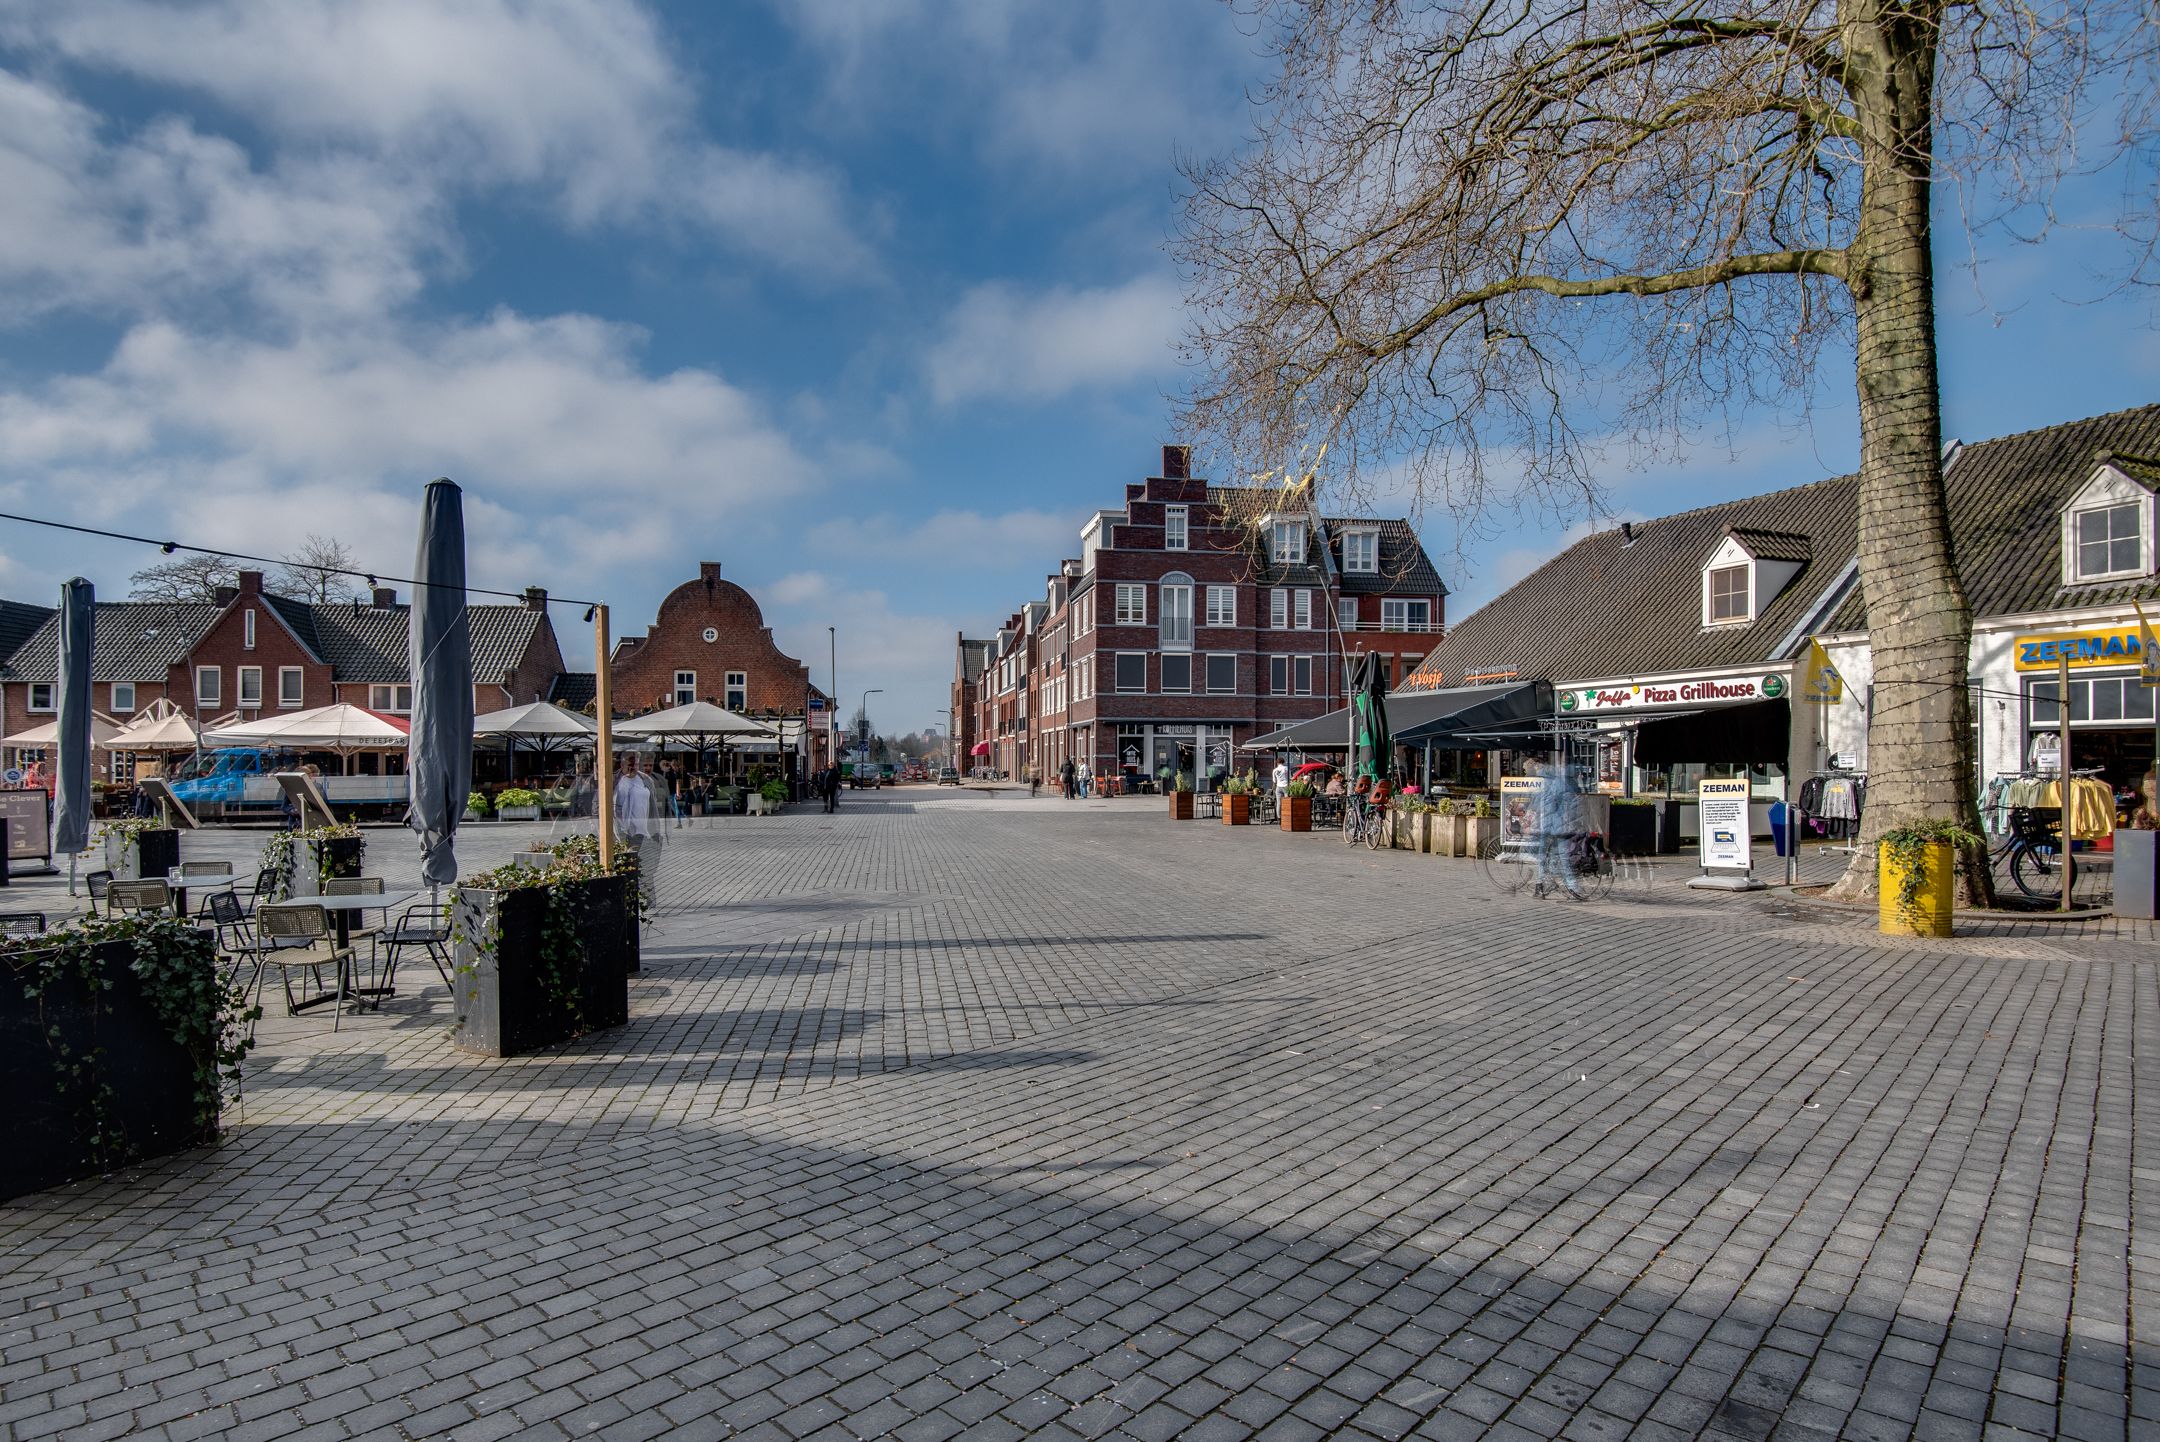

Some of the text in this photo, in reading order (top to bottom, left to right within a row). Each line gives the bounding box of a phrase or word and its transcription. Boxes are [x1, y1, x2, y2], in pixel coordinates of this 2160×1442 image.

[2020, 634, 2141, 662] ZEEMAN
[1595, 681, 1755, 707] Jaffa Pizza Grillhouse
[1703, 784, 1745, 793] ZEEMAN
